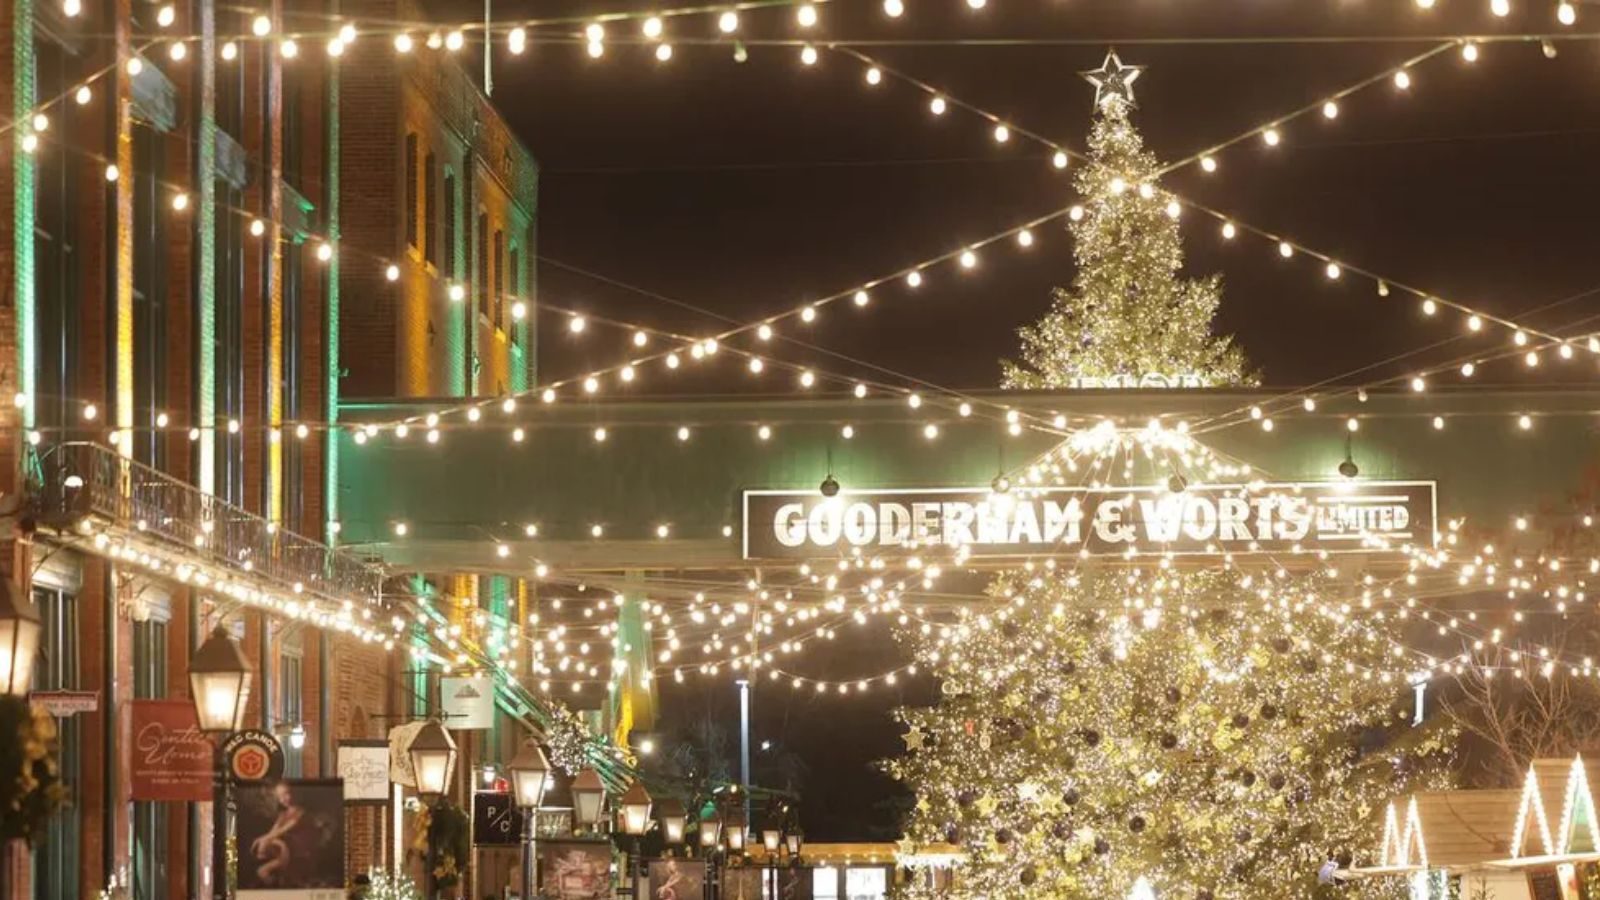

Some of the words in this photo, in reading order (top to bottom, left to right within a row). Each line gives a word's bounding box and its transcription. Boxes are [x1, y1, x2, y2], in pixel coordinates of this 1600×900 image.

[774, 498, 1081, 547] GOODERHAM
[1096, 498, 1137, 542] &
[1140, 497, 1312, 541] WORTS
[1316, 504, 1409, 531] LIMITED
[245, 731, 278, 753] CANOE
